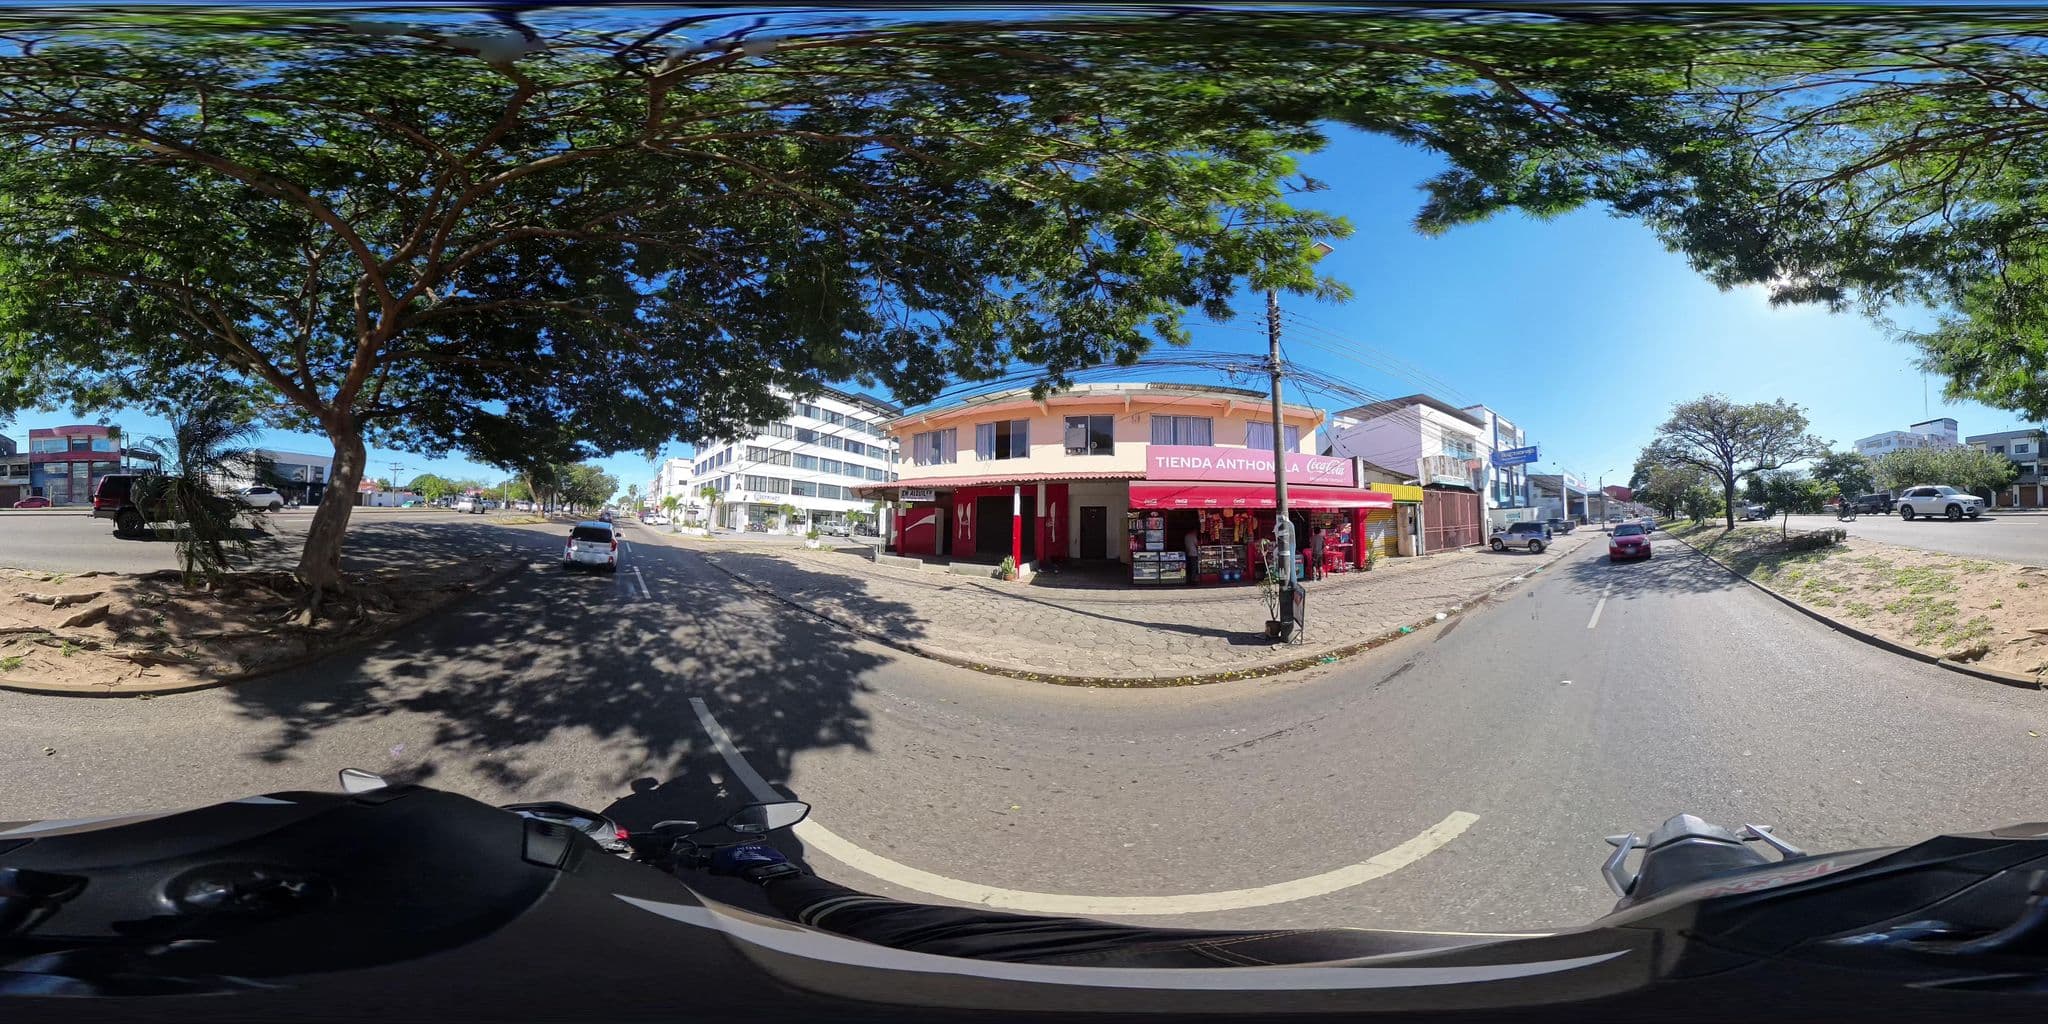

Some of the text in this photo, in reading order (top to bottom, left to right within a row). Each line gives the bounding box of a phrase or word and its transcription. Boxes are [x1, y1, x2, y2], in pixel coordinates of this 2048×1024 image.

[1155, 456, 1300, 473] TIENDA ANTHONLA
[1306, 457, 1345, 476] Coca-Cola
